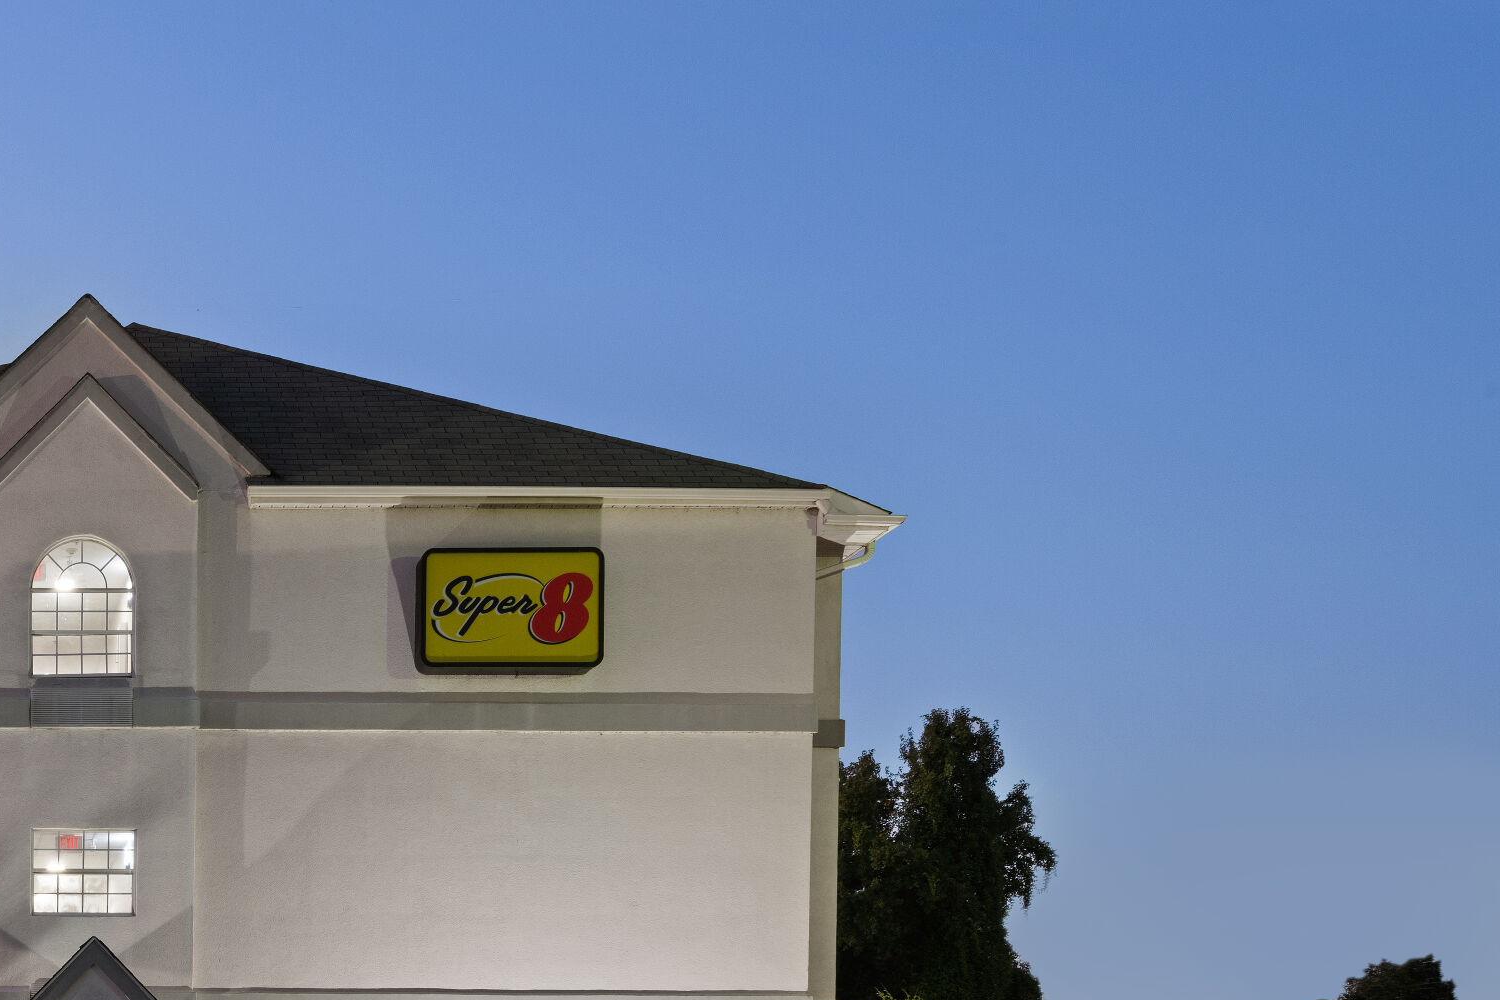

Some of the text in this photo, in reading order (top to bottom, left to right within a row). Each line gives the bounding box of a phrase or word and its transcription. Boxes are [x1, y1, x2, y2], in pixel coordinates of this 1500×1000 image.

[431, 572, 593, 644] Super 8
[60, 836, 79, 849] EXIT
